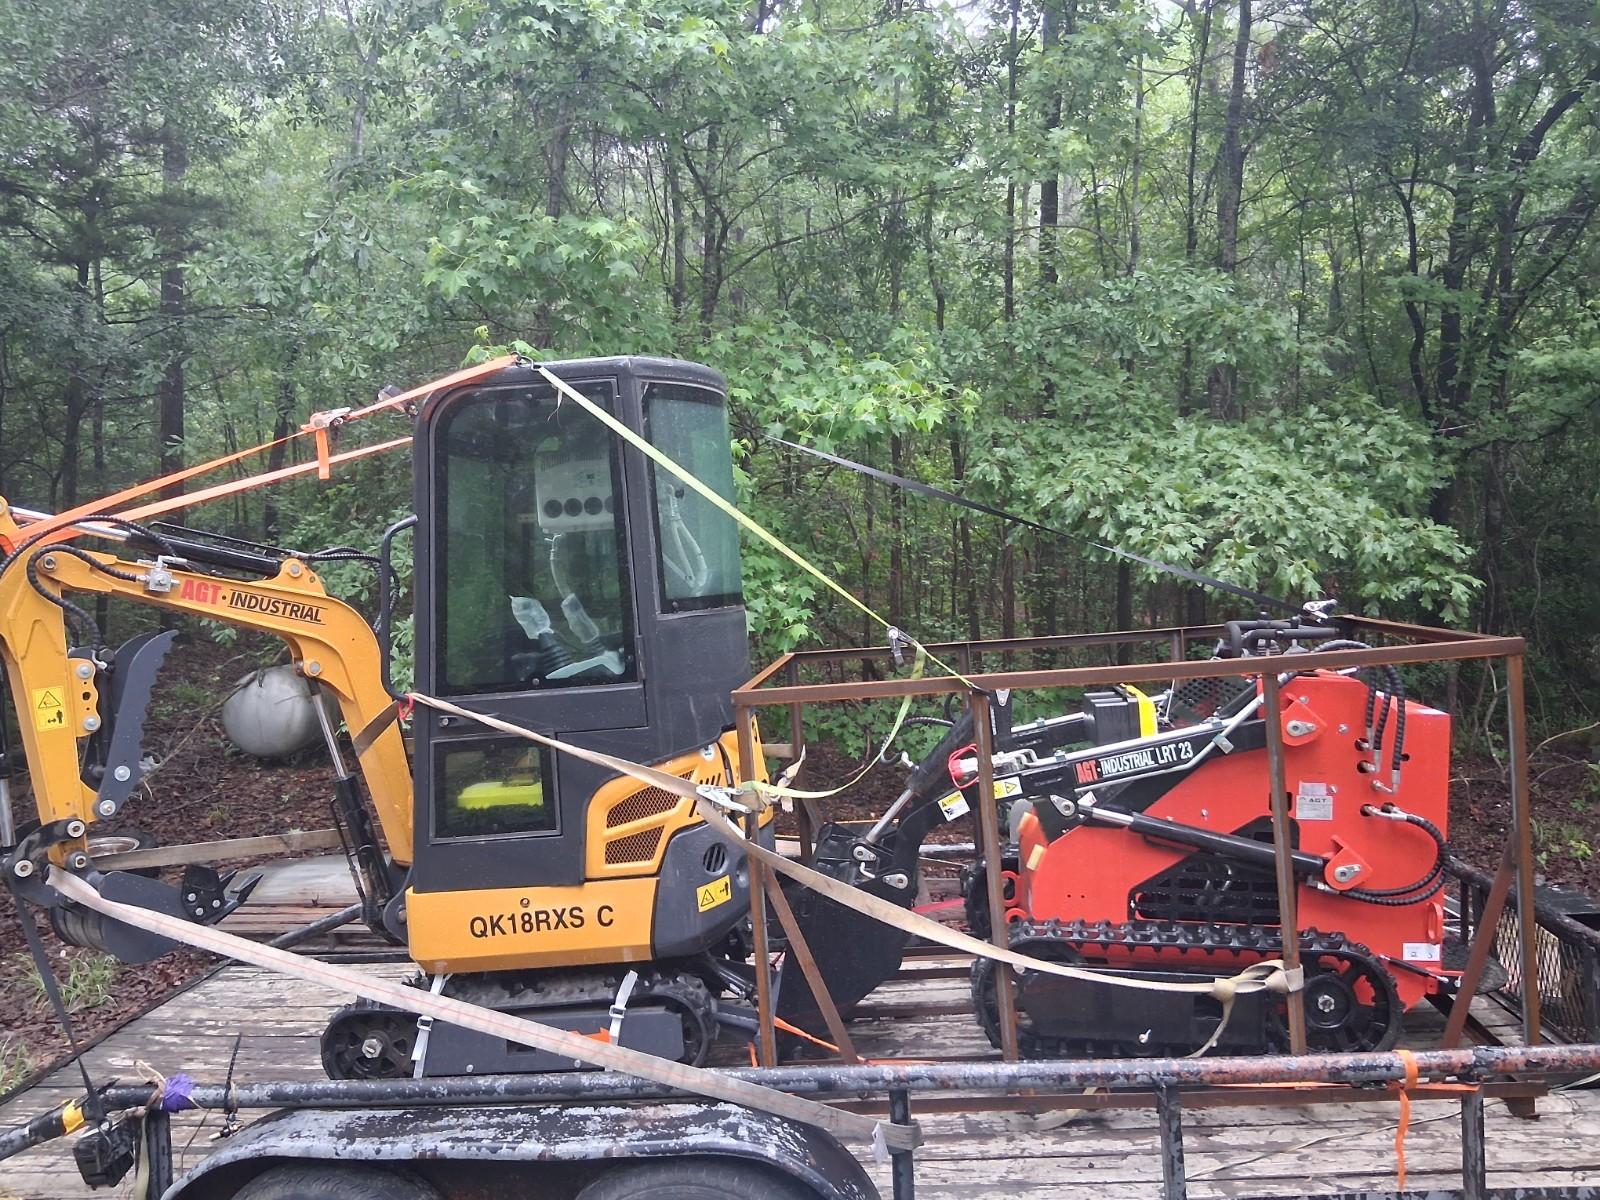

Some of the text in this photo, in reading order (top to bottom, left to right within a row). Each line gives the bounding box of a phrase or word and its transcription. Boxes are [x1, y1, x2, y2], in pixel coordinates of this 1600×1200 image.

[180, 579, 322, 622] AGT INDUSTRIAL
[1075, 741, 1193, 783] AGT INDUSTRIAL LRT 23
[469, 904, 614, 938] QK18RXS C
